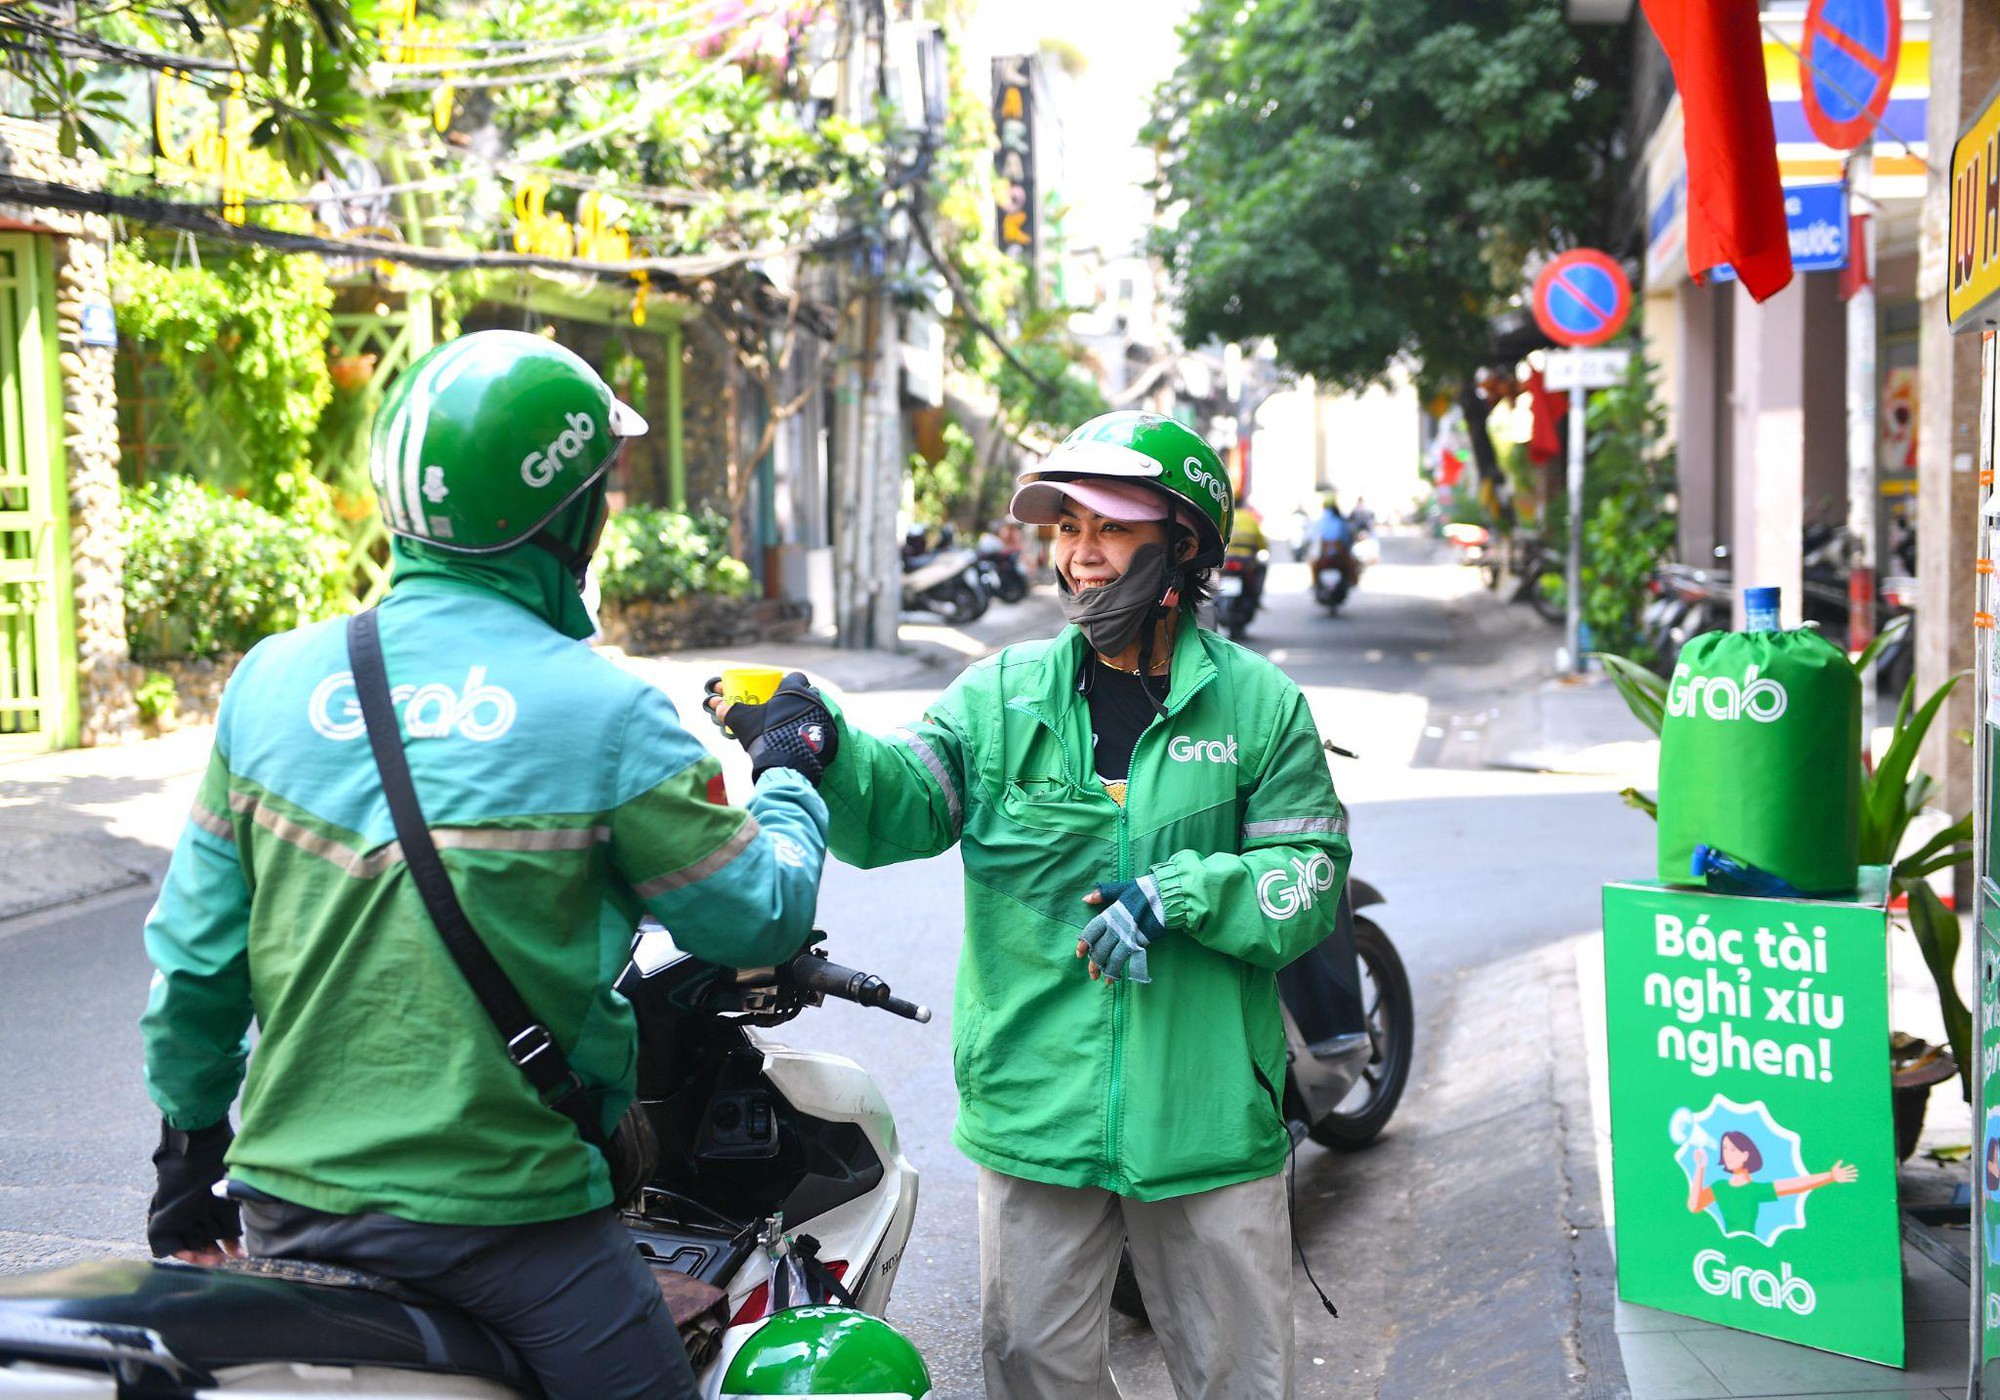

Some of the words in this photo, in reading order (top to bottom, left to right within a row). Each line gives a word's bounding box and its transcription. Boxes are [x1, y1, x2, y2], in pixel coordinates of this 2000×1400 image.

[521, 412, 595, 488] Grab
[1183, 456, 1230, 512] Grab
[1667, 663, 1788, 723] Grab
[1655, 913, 1744, 965] Bác
[1754, 921, 1827, 973] tài
[1644, 966, 1752, 1024] nghỉ
[1763, 977, 1844, 1029] xíu
[1657, 1021, 1833, 1083] nghen!
[1693, 1249, 1816, 1315] Grab
